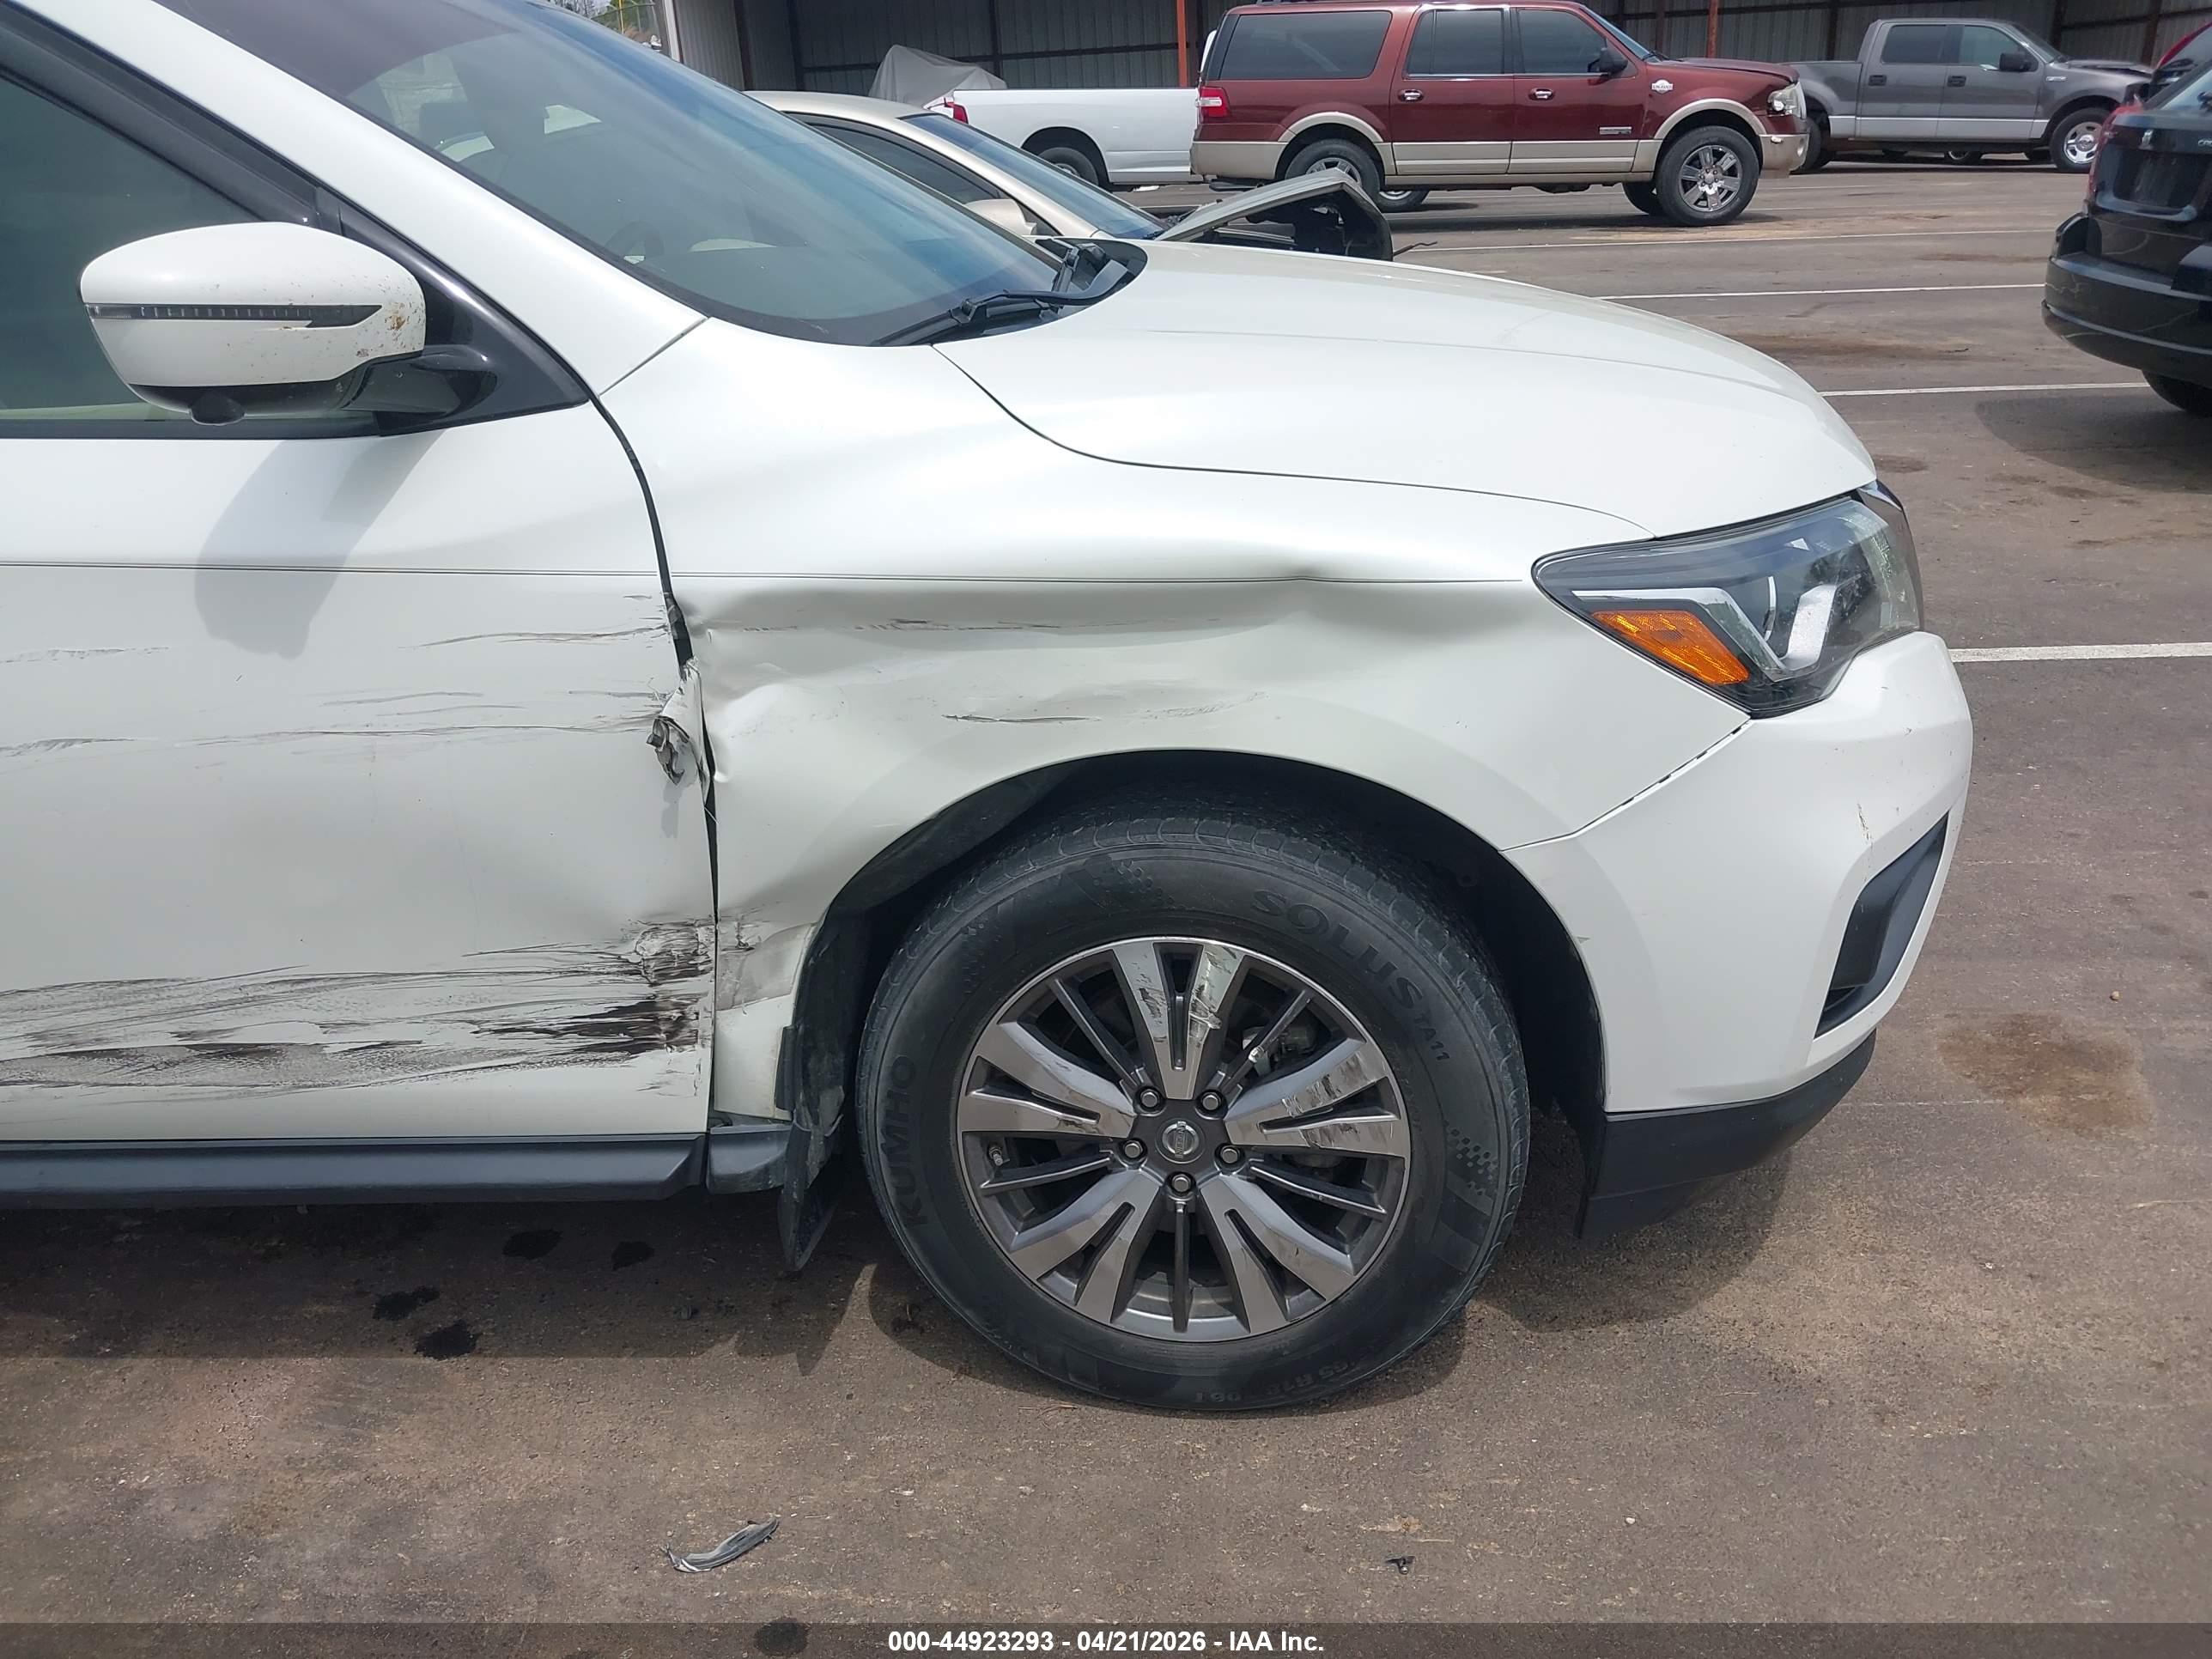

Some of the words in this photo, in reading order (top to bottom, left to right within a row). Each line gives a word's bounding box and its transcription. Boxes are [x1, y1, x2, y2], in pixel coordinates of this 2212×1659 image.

[1250, 889, 1424, 1009] SOLUS
[1413, 1010, 1450, 1061] TA11
[880, 1054, 929, 1226] KUMHO
